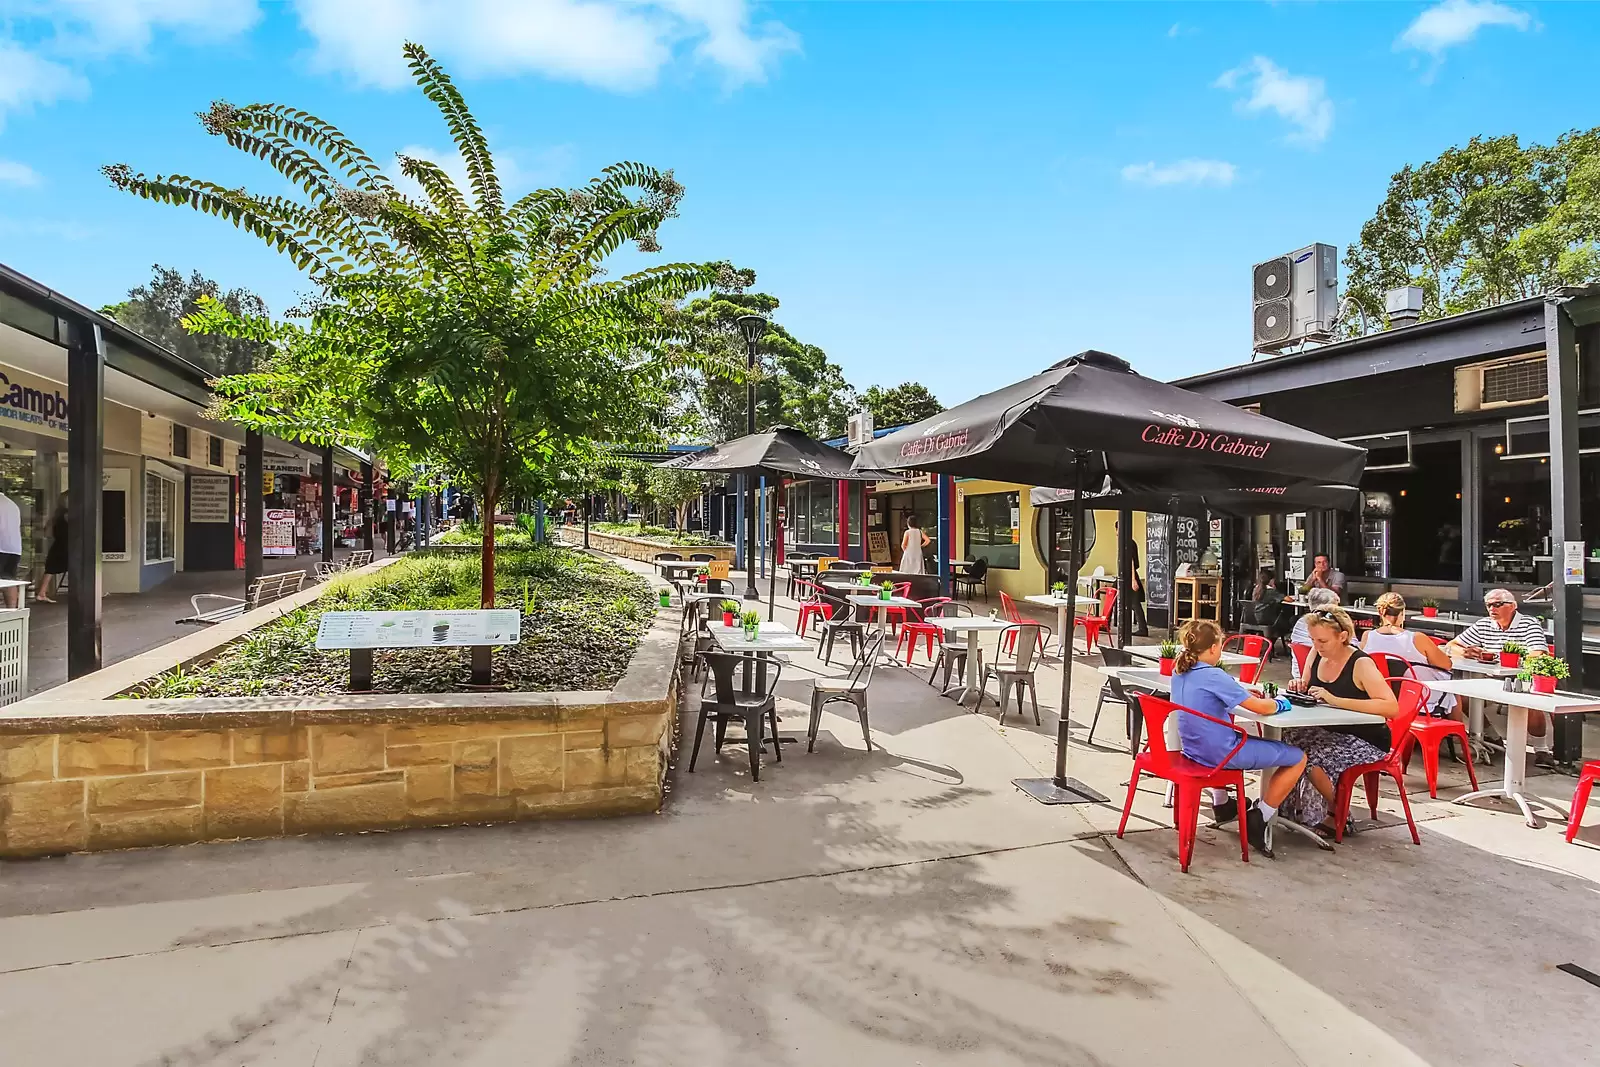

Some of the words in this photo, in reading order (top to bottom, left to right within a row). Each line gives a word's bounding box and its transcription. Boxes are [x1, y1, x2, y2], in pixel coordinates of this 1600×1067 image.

[0, 372, 68, 421] Campb
[900, 439, 923, 457] Caffe
[923, 436, 935, 454] Di
[935, 428, 969, 451] Gabriel
[1141, 424, 1185, 446] Caffe
[1185, 430, 1210, 450] Di
[1210, 434, 1271, 459] Gabriel
[268, 511, 283, 519] IGA
[1176, 549, 1198, 562] Rolls
